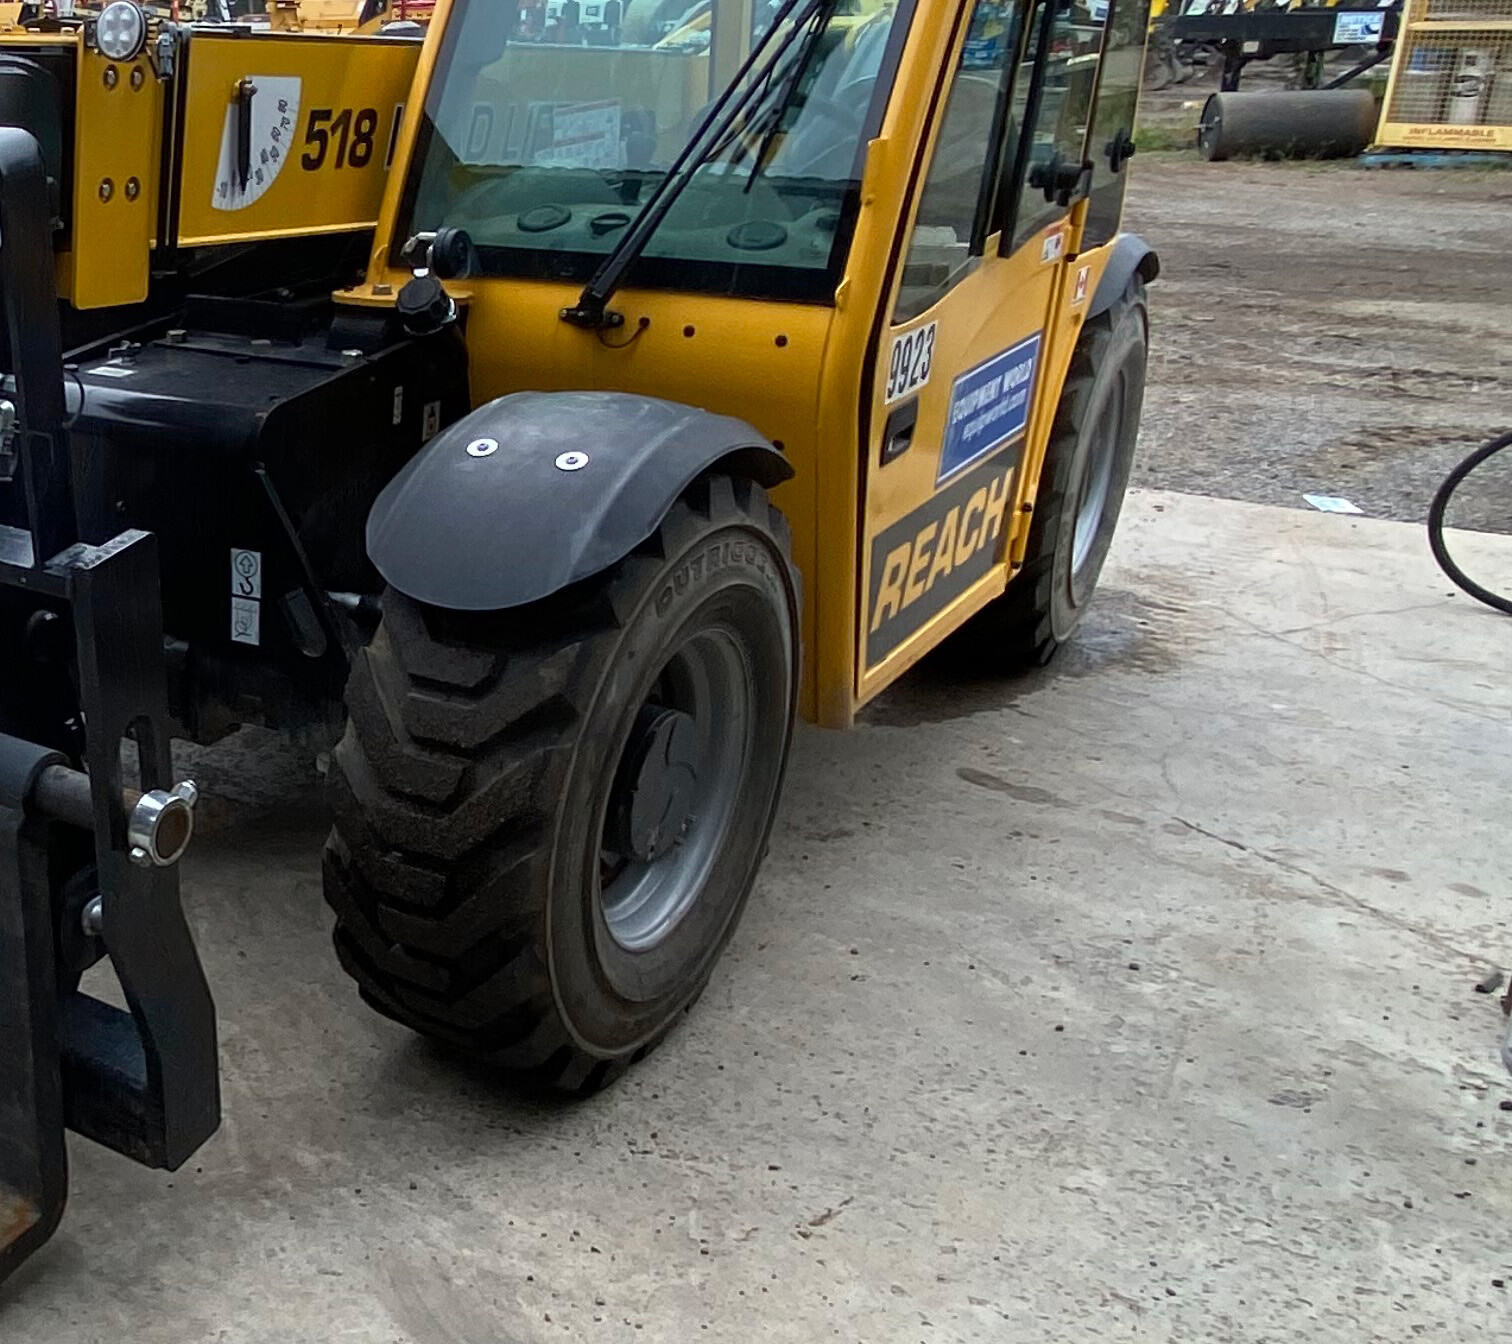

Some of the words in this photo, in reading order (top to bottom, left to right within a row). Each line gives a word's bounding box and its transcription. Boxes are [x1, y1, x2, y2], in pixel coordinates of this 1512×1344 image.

[301, 107, 378, 173] 518
[887, 323, 936, 399] 9923
[870, 466, 1015, 634] REACH
